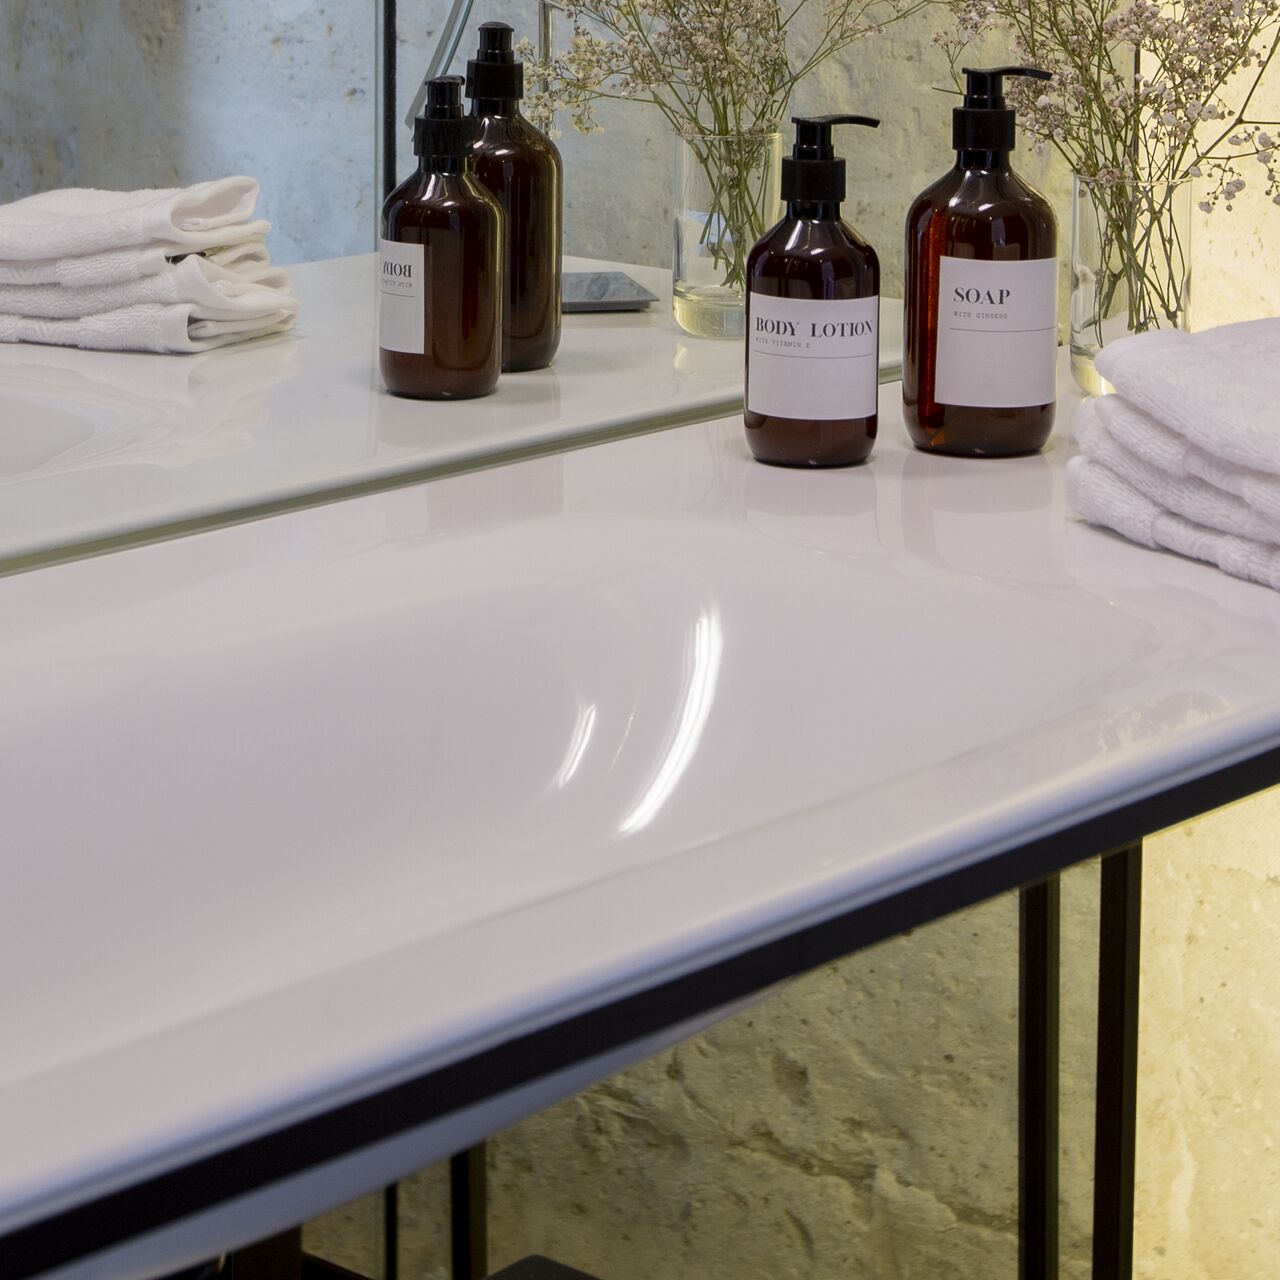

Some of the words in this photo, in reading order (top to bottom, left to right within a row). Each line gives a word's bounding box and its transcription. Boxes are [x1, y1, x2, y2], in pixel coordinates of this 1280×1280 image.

[953, 287, 1010, 305] SOAP
[953, 311, 971, 320] WITH
[756, 317, 800, 336] BODY
[811, 320, 873, 338] LOTION
[772, 338, 802, 348] VITAMIN
